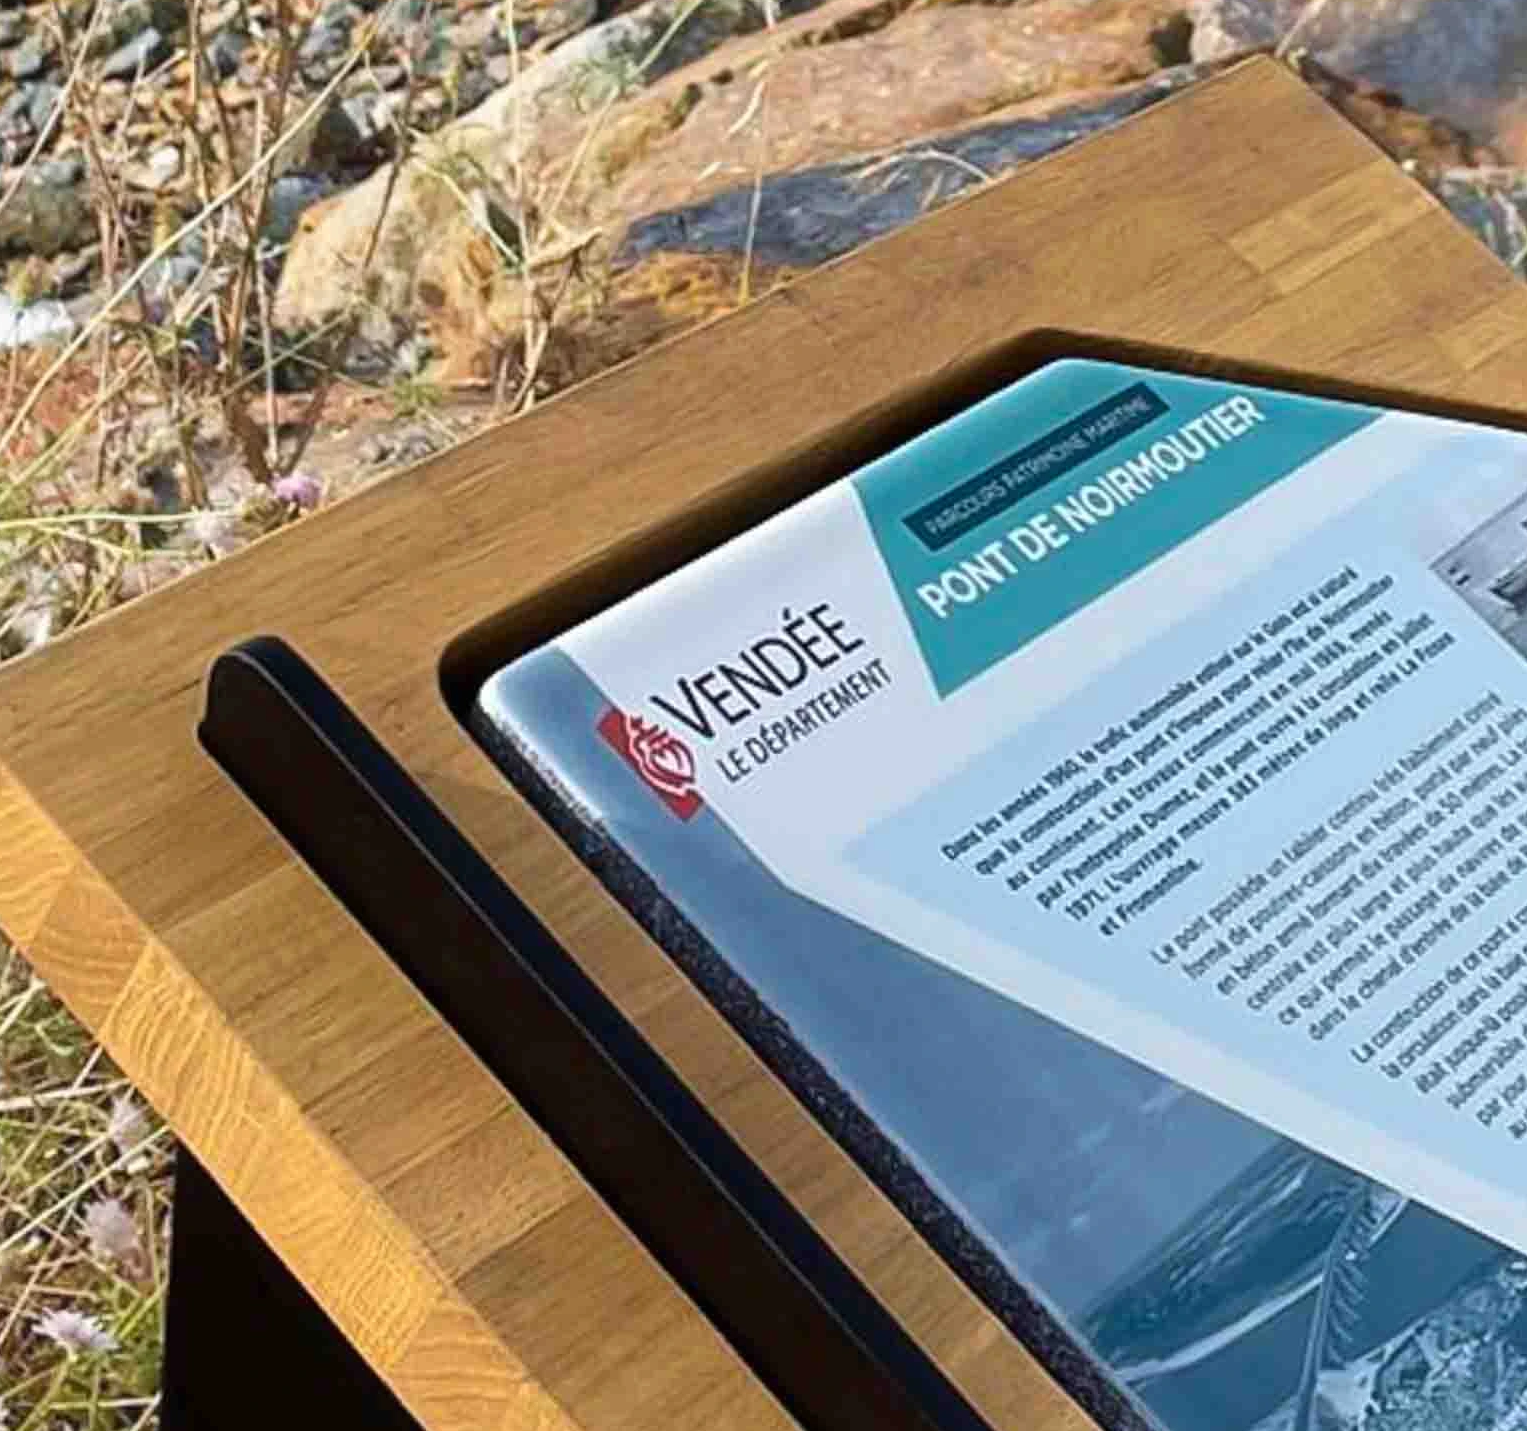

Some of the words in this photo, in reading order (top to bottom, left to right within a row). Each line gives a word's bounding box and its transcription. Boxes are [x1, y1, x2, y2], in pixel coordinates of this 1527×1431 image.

[917, 541, 1016, 617] PONT
[1007, 513, 1069, 560] DE
[1056, 396, 1262, 530] NOIRMOUTIER
[924, 480, 1006, 533] PARCOURS
[1001, 432, 1087, 487] PATRIMOINE
[1083, 396, 1149, 439] MARITIME
[652, 605, 861, 737] VENDÉE
[715, 748, 751, 783] LE
[745, 658, 889, 763] DÉPARTEMENT
[940, 830, 982, 860] Dans
[975, 816, 1002, 836] les
[999, 784, 1048, 821] années
[1076, 749, 1098, 764] le
[1092, 725, 1131, 754] trafic
[1127, 680, 1197, 732] automobile
[1195, 652, 1234, 685] estival
[1232, 640, 1253, 659] sur
[1248, 631, 1266, 645] le
[1261, 613, 1293, 637] Gois
[1289, 599, 1311, 619] est
[1307, 592, 1322, 607] si
[1318, 566, 1358, 599] saturé
[975, 848, 1007, 875] que
[1000, 837, 1023, 855] la
[1020, 779, 1105, 842] construction
[1102, 756, 1136, 784] d'un
[1132, 733, 1168, 765] pont
[1164, 695, 1224, 740] s'impose
[1220, 673, 1253, 703] pour
[1249, 651, 1284, 679] relier
[1305, 624, 1326, 642] de
[1320, 575, 1393, 628] Noirmoutier
[1005, 870, 1030, 891] au
[1027, 817, 1105, 874] continent.
[1099, 795, 1133, 821] Les
[1127, 758, 1185, 801] travaux
[1183, 695, 1271, 762] commencent
[1269, 683, 1290, 701] en
[1287, 662, 1316, 688] mai
[1348, 610, 1392, 643] menés
[1036, 880, 1066, 909] par
[1061, 824, 1145, 886] l'entreprise
[1193, 771, 1214, 791] et
[1205, 763, 1228, 780] le
[1223, 739, 1259, 771] pont
[1256, 713, 1296, 745] ouvre
[1291, 704, 1307, 719] à
[1299, 695, 1321, 711] la
[1316, 650, 1383, 700] circulation
[1380, 638, 1400, 655] en
[1393, 612, 1434, 645] juillet
[1103, 835, 1179, 893] L'ouvrage
[1177, 797, 1231, 839] mesure
[1256, 741, 1307, 780] mètres
[1303, 727, 1325, 745] de
[1319, 704, 1358, 732] long
[1353, 691, 1372, 709] et
[1369, 671, 1400, 697] relie
[1395, 658, 1419, 676] La
[1413, 631, 1455, 662] Fosse
[1099, 916, 1120, 936] et
[1115, 858, 1201, 922] Fromentine.
[1149, 943, 1177, 964] Le
[1173, 915, 1211, 951] pont
[1208, 873, 1268, 924] possède
[1265, 857, 1288, 878] un
[1281, 825, 1328, 862] tablier
[1327, 789, 1379, 830] continu
[1372, 767, 1405, 792] très
[1398, 718, 1466, 772] faiblement
[1181, 939, 1231, 979] formé
[1227, 924, 1251, 946] de
[1248, 841, 1359, 932] poutres-caissons
[1355, 825, 1378, 845] en
[1413, 765, 1452, 801] porté
[1447, 749, 1472, 774] par
[1469, 724, 1499, 755] neuf
[1216, 974, 1238, 995] en
[1230, 943, 1278, 980] béton
[1275, 912, 1313, 948] armé
[1305, 873, 1362, 919] formant
[1377, 823, 1428, 862] travées
[1424, 809, 1446, 828] de
[1437, 791, 1463, 814] 50
[1459, 763, 1506, 799] mètres.
[1497, 749, 1522, 766] La
[1246, 960, 1306, 1010] centrale
[1303, 939, 1330, 965] est
[1325, 917, 1358, 948] plus
[1351, 889, 1393, 922] large
[1389, 873, 1410, 894] et
[1405, 854, 1438, 884] plus
[1429, 824, 1473, 858] haute
[1469, 804, 1498, 829] que
[1489, 788, 1517, 808] les
[1277, 1005, 1301, 1025] ce
[1296, 985, 1323, 1009] qui
[1321, 943, 1373, 992] permet
[1365, 932, 1389, 950] le
[1384, 889, 1441, 939] passage
[1437, 873, 1460, 894] de
[1499, 823, 1522, 842] de
[1308, 1007, 1346, 1040] dans
[1337, 994, 1362, 1011] le
[1357, 956, 1403, 999] chenal
[1399, 918, 1453, 964] d'entrée
[1449, 902, 1471, 922] de
[1463, 891, 1485, 908] la
[1475, 870, 1510, 897] baie
[1506, 855, 1527, 875] de
